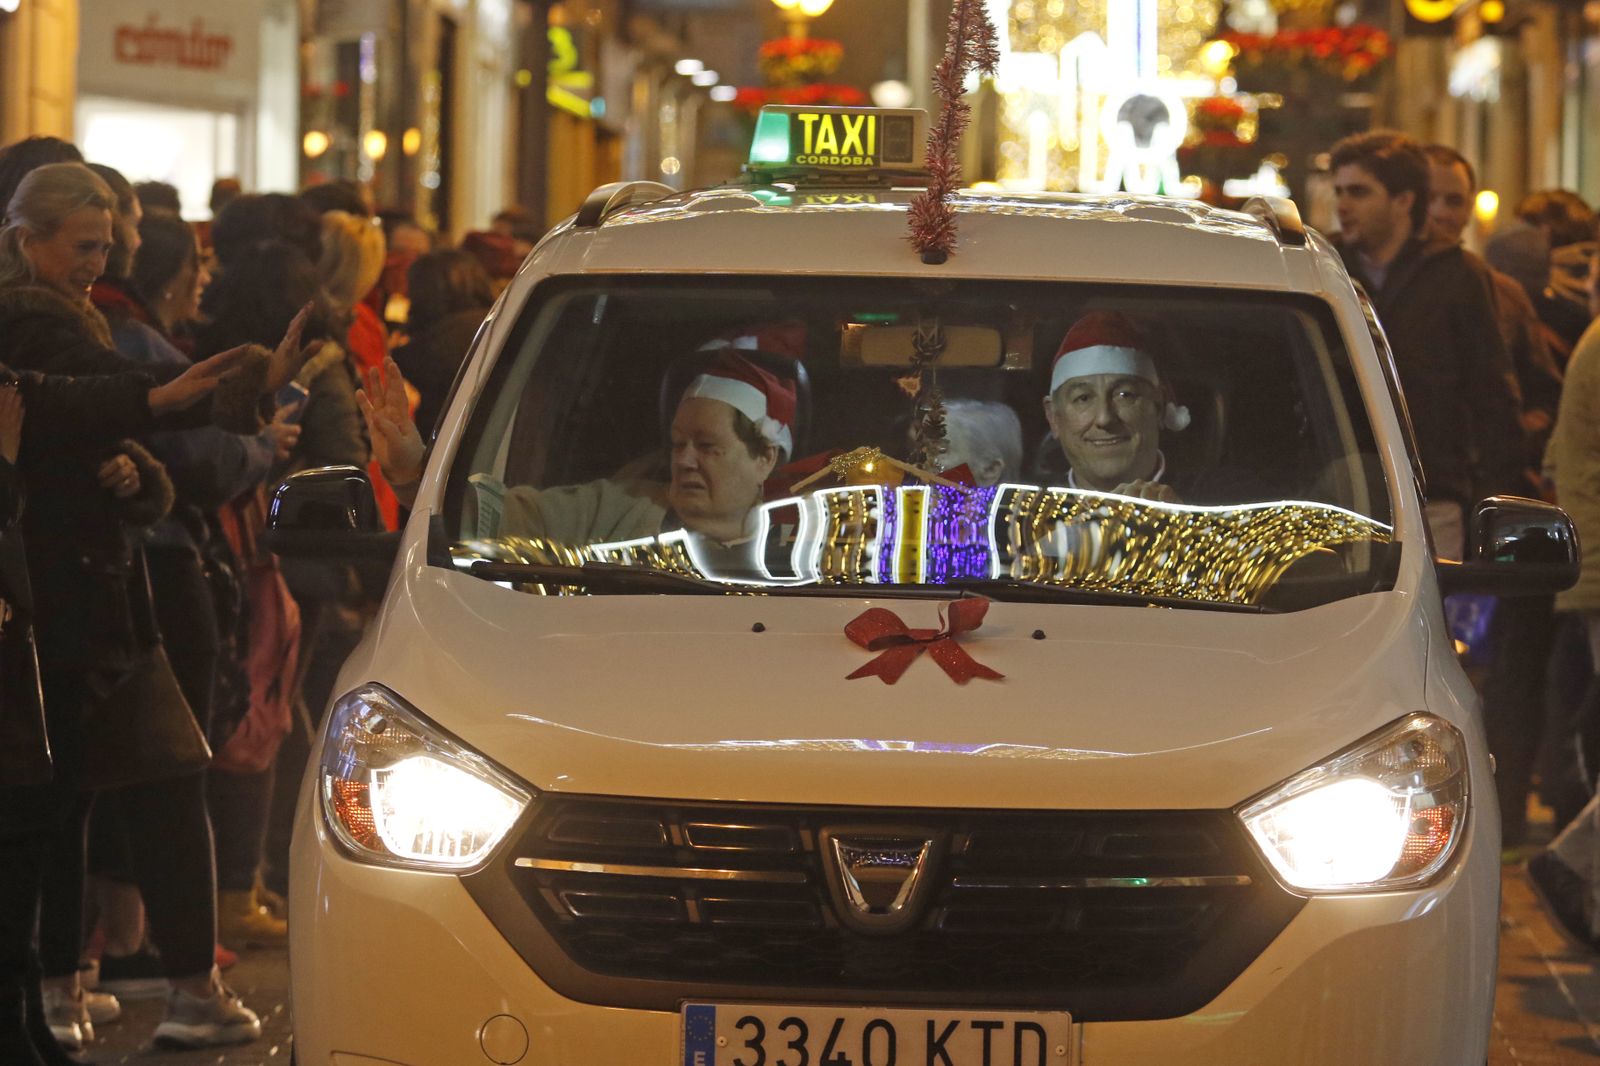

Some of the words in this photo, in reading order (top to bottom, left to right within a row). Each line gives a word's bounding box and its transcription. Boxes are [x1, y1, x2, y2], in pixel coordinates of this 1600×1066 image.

[798, 113, 876, 155] TAXI
[796, 155, 873, 166] CORDOBA
[733, 1015, 897, 1066] 3340
[926, 1019, 1047, 1066] KTD
